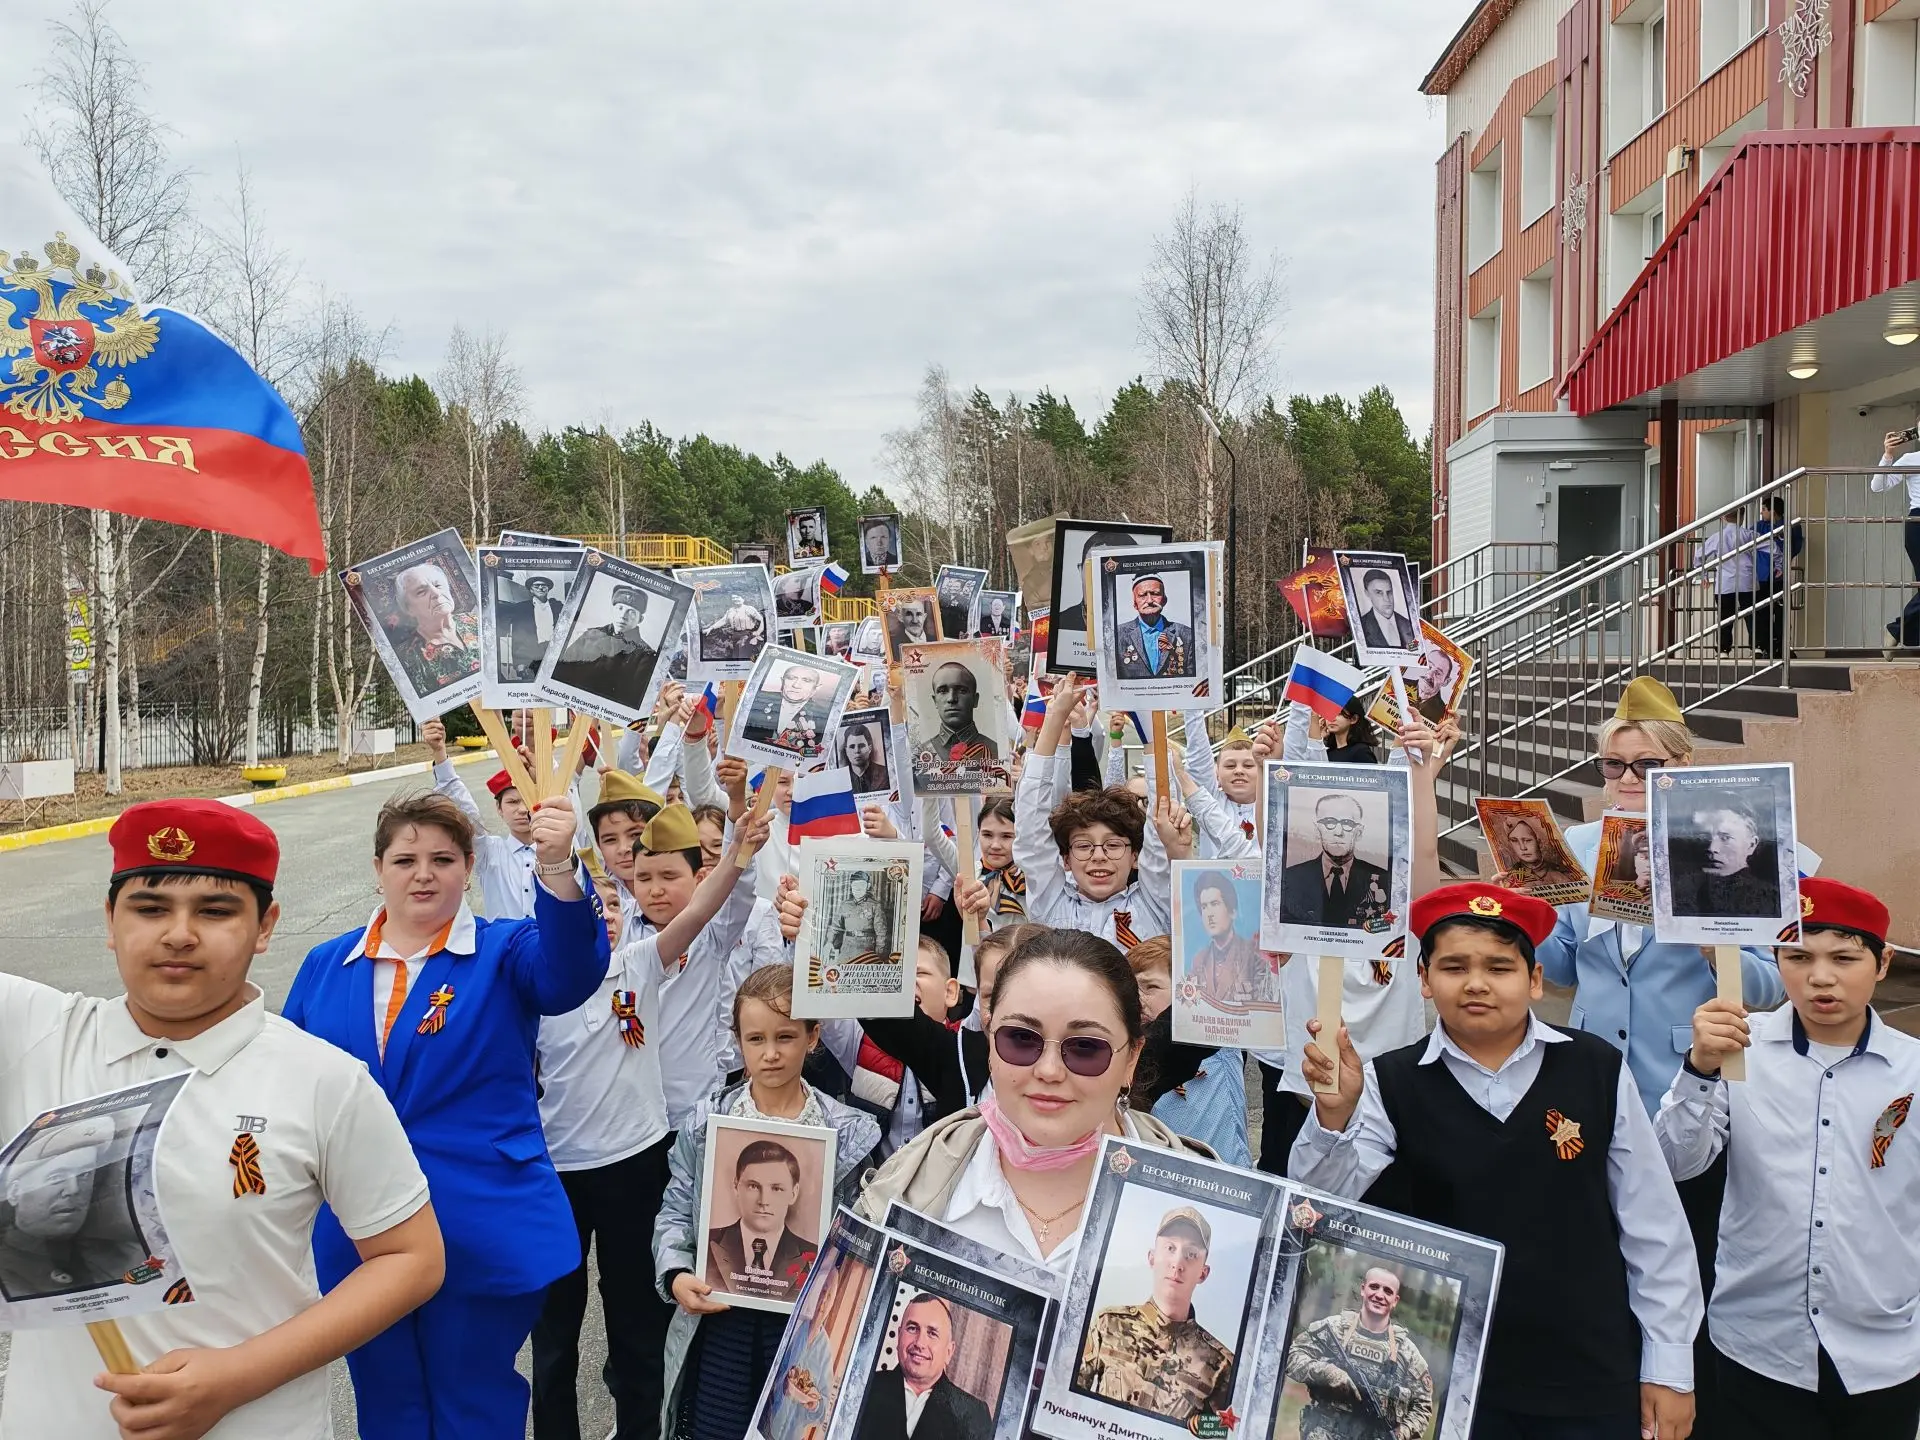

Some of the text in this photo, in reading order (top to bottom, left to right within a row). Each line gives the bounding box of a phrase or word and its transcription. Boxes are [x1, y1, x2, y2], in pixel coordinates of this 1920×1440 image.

[366, 543, 436, 576] БЕССМЕРТНЫЙ ПОЛК
[1122, 558, 1183, 568] БЕССМЕРТНЫЙ ПОЛК
[607, 562, 672, 592] БЕССМЕРТНЫЙ ПОЛК
[72, 645, 84, 656] 20
[570, 695, 600, 711] Василий
[980, 758, 1005, 767] Иван
[1298, 773, 1379, 784] БЕССМЕРТНЫЙ ПОЛК
[1680, 776, 1737, 785] БЕССМЕРТНЫЙ
[124, 1090, 152, 1103] ПОЛК
[1141, 1164, 1253, 1202] БЕССМЕРТНЫЙ ПОЛК
[856, 1236, 872, 1252] ПОЛК
[1328, 1219, 1451, 1262] БЕССМЕРТНЫЙ ПОЛК
[914, 1264, 1007, 1308] БЕССМЕРТНЫЙ ПОЛК
[1354, 1344, 1381, 1360] СОЛО
[1042, 1400, 1107, 1430] Лукьянчук
